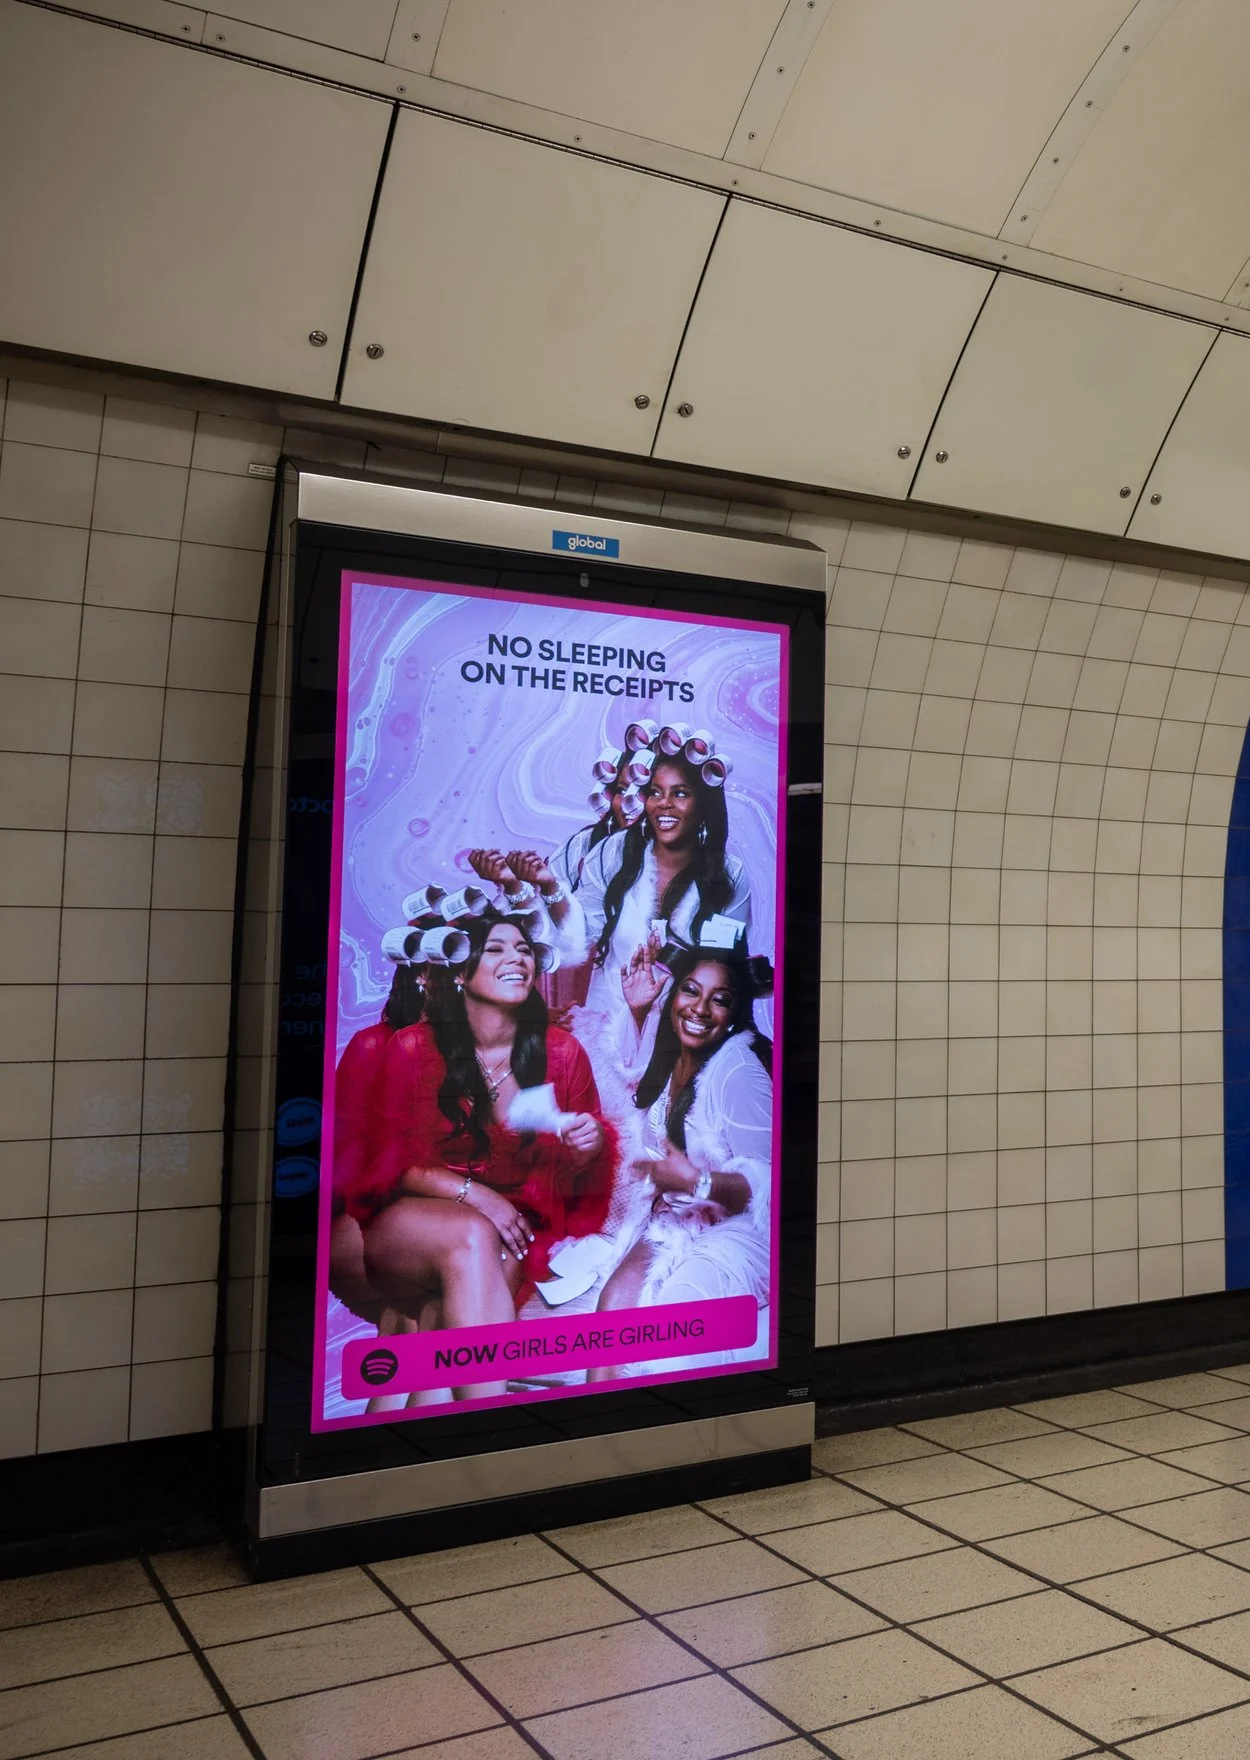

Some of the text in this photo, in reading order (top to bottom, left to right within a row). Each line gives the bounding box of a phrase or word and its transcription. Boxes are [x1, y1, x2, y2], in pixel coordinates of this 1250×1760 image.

[567, 534, 607, 552] global
[488, 633, 667, 673] NO SLEEPING
[460, 660, 695, 704] ON THE RECEIPTS
[434, 1319, 705, 1369] NOW GIRLS ARE GIRLING
